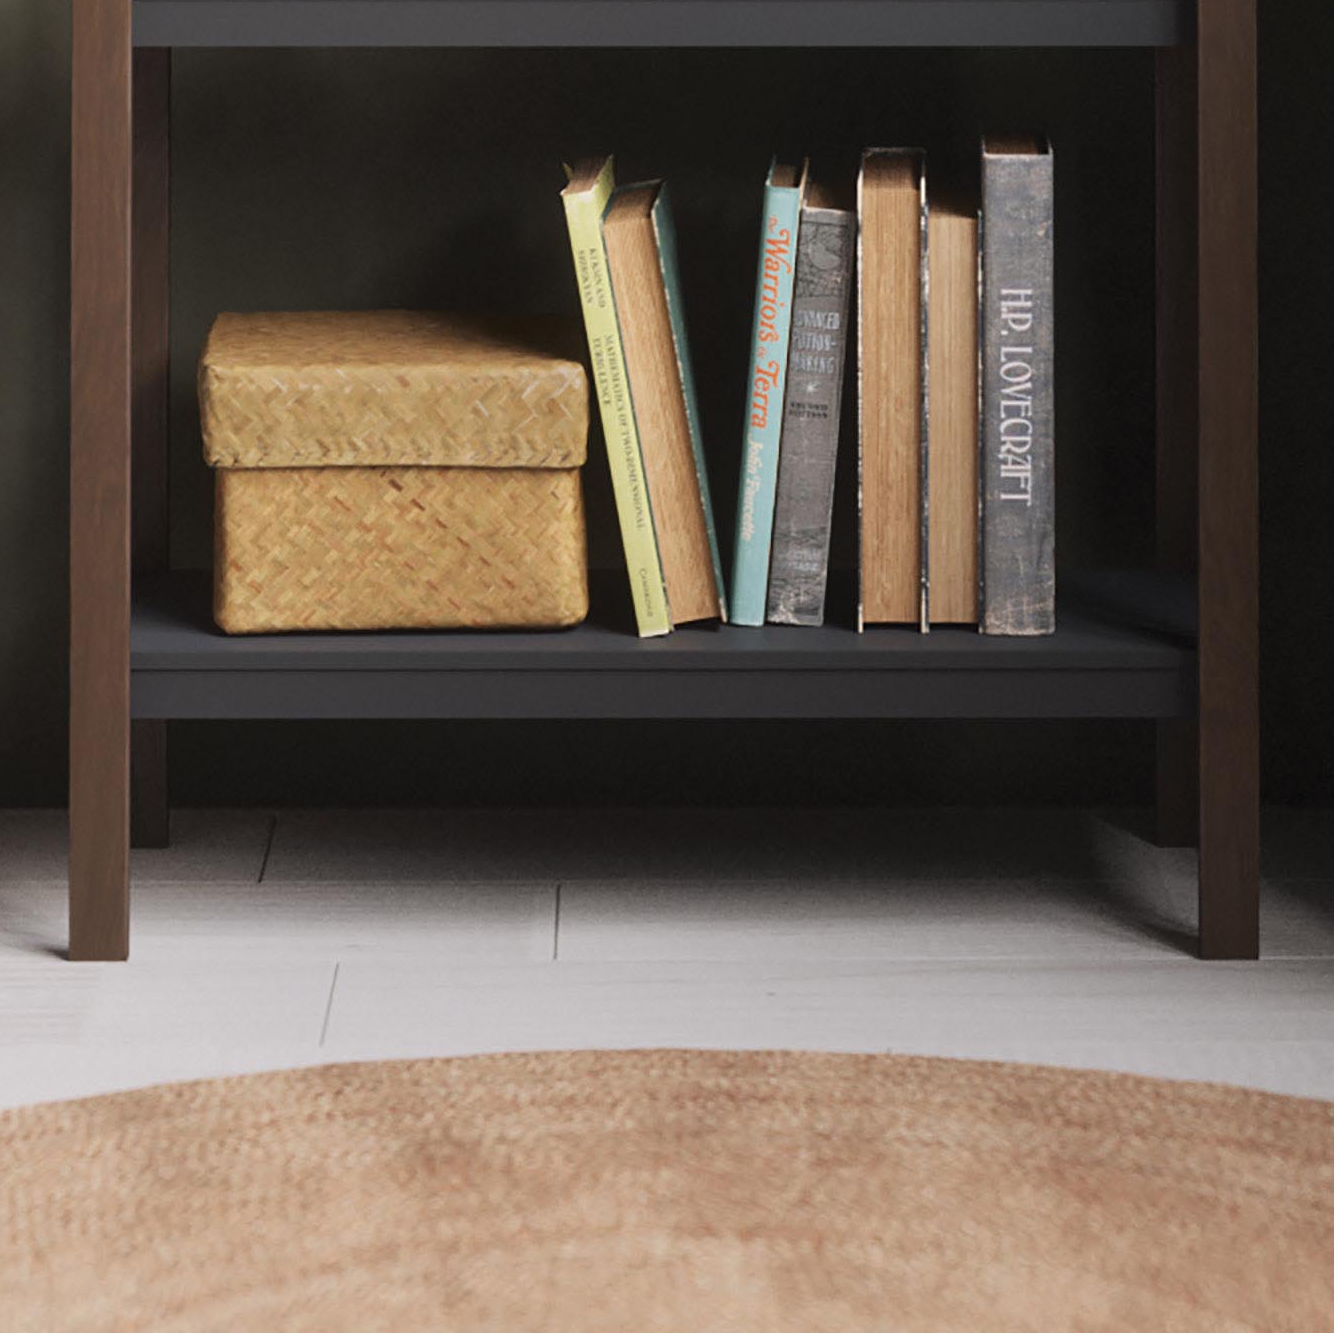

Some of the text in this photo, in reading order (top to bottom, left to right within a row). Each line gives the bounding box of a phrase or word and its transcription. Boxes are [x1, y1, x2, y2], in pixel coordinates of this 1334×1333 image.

[757, 228, 792, 343] Warriors
[750, 360, 781, 429] Terra
[999, 346, 1035, 507] LOVECRAFT
